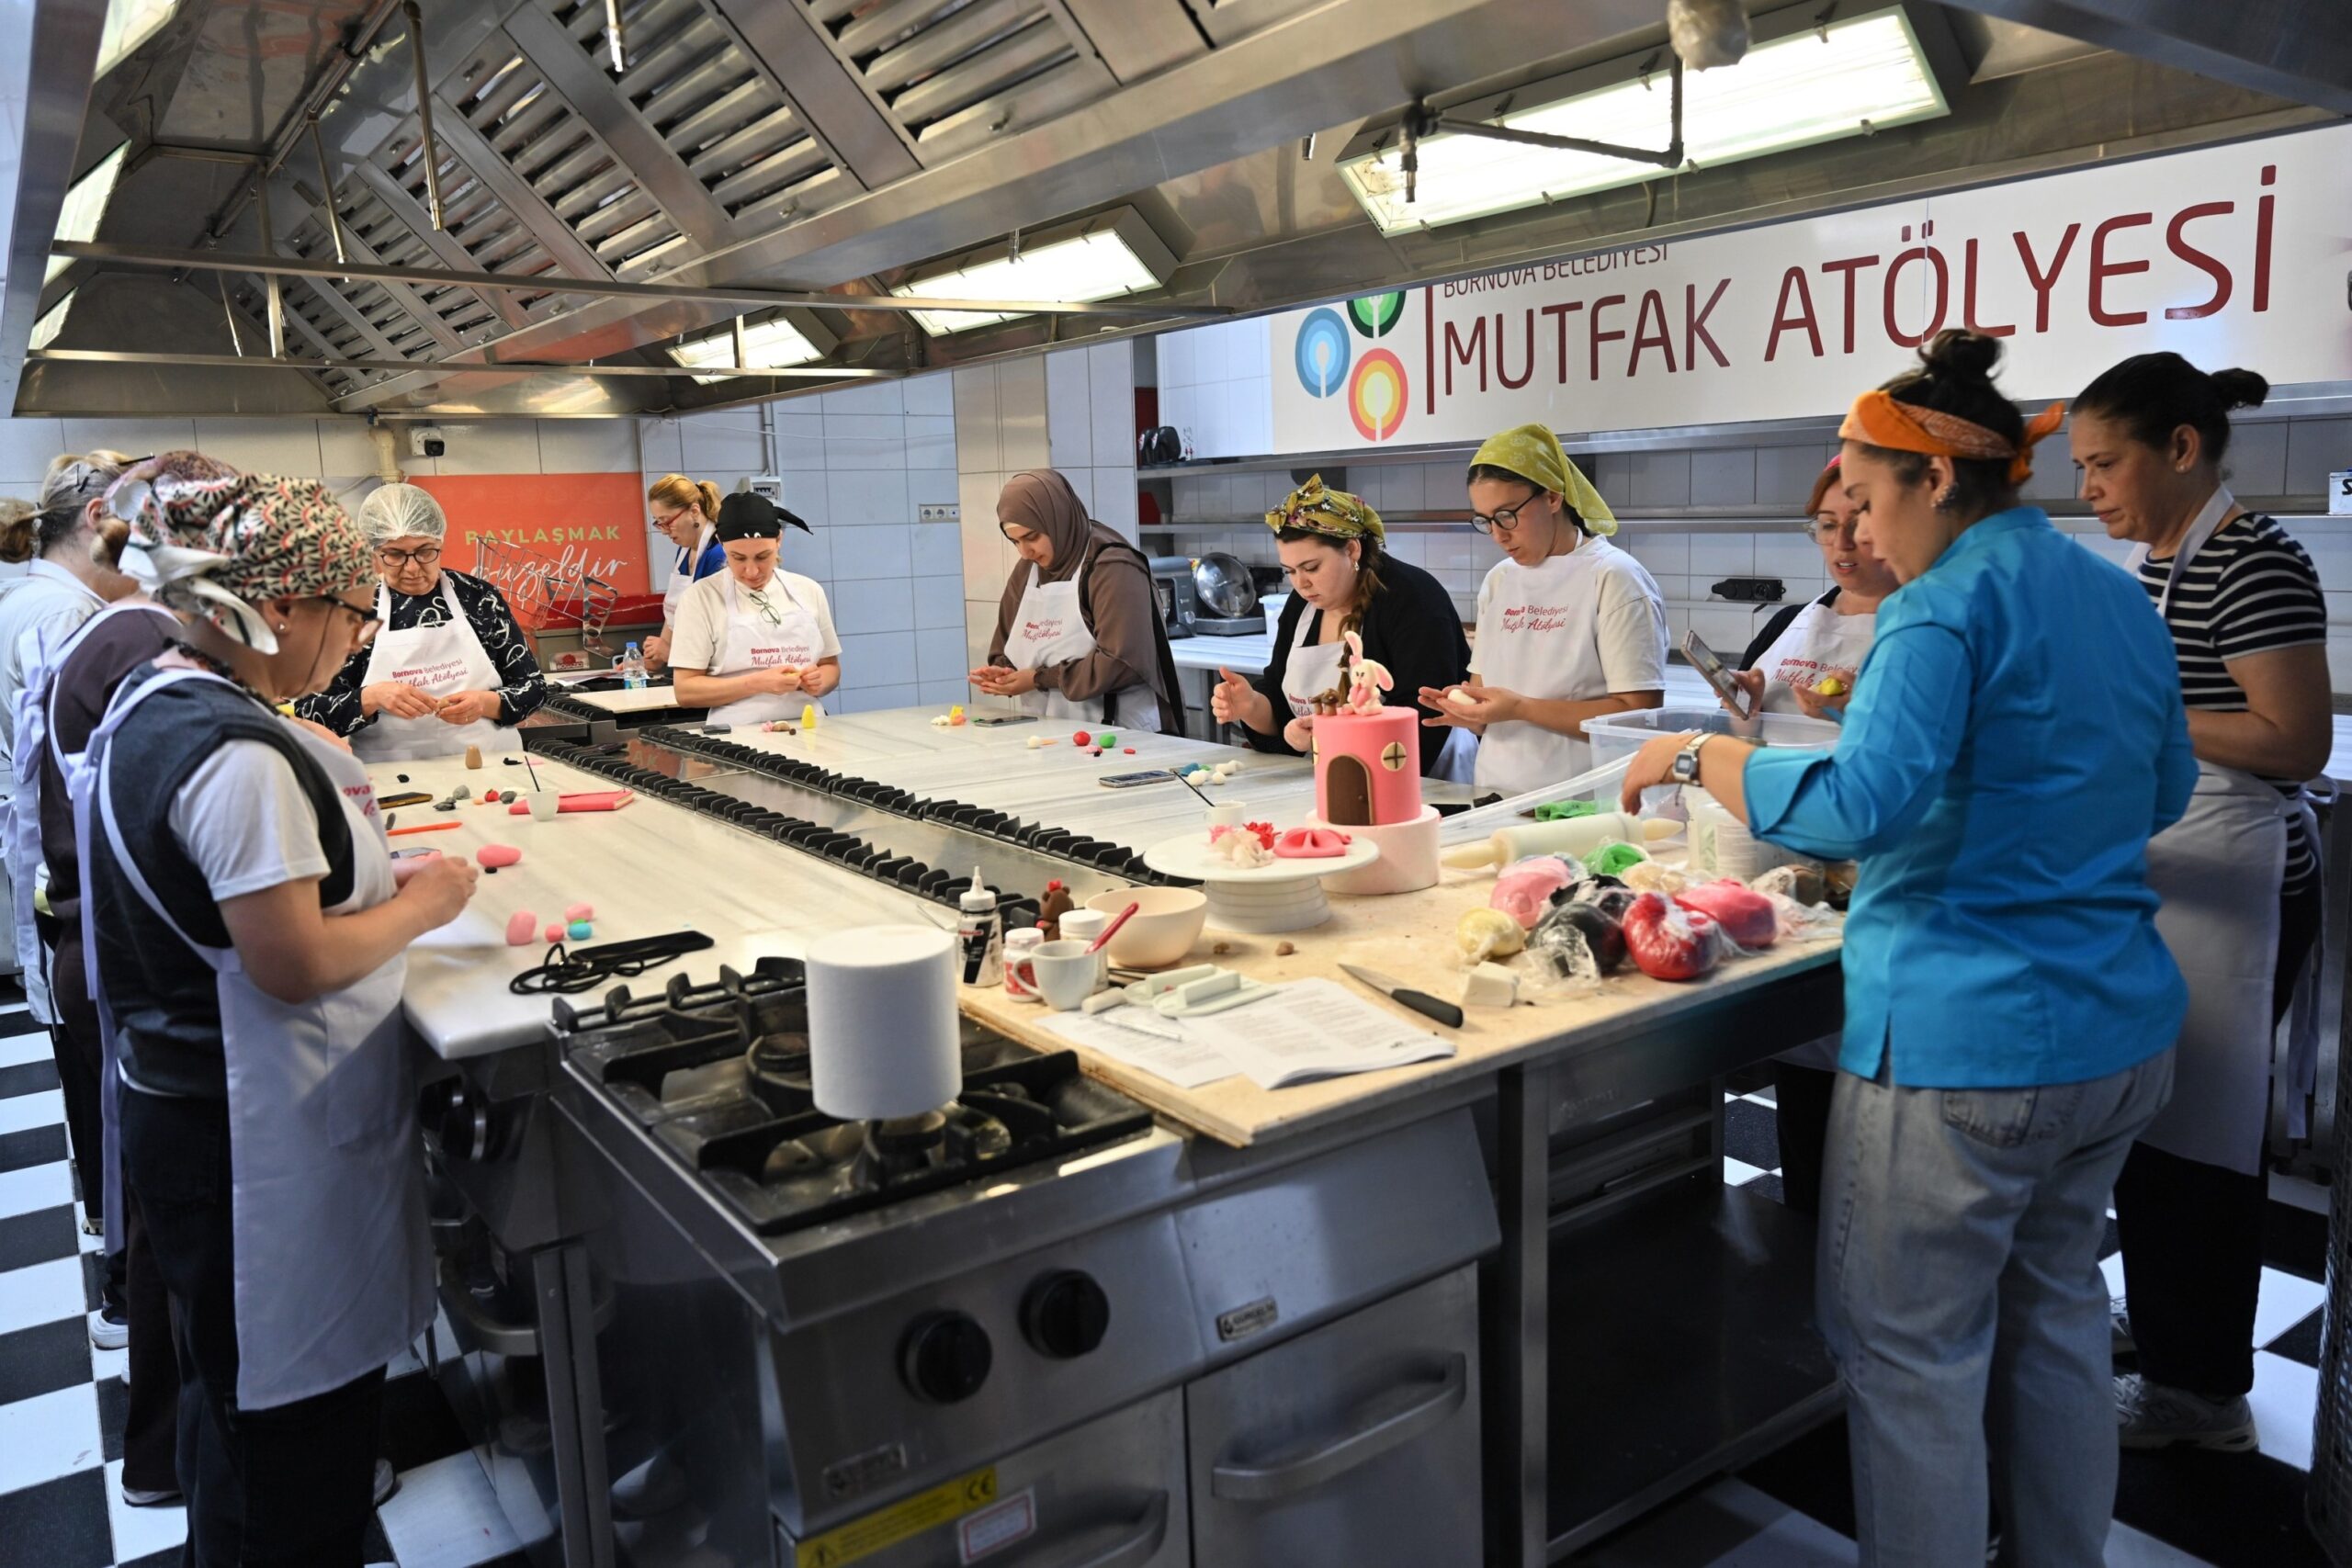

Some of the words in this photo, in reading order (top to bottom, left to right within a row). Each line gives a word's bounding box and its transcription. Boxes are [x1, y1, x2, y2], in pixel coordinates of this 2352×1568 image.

[1444, 277, 1732, 396] MUTFAK
[1764, 164, 2277, 362] ATÖLYESİ
[465, 525, 620, 545] PAYLAŞMAK
[391, 668, 424, 679] Bornova
